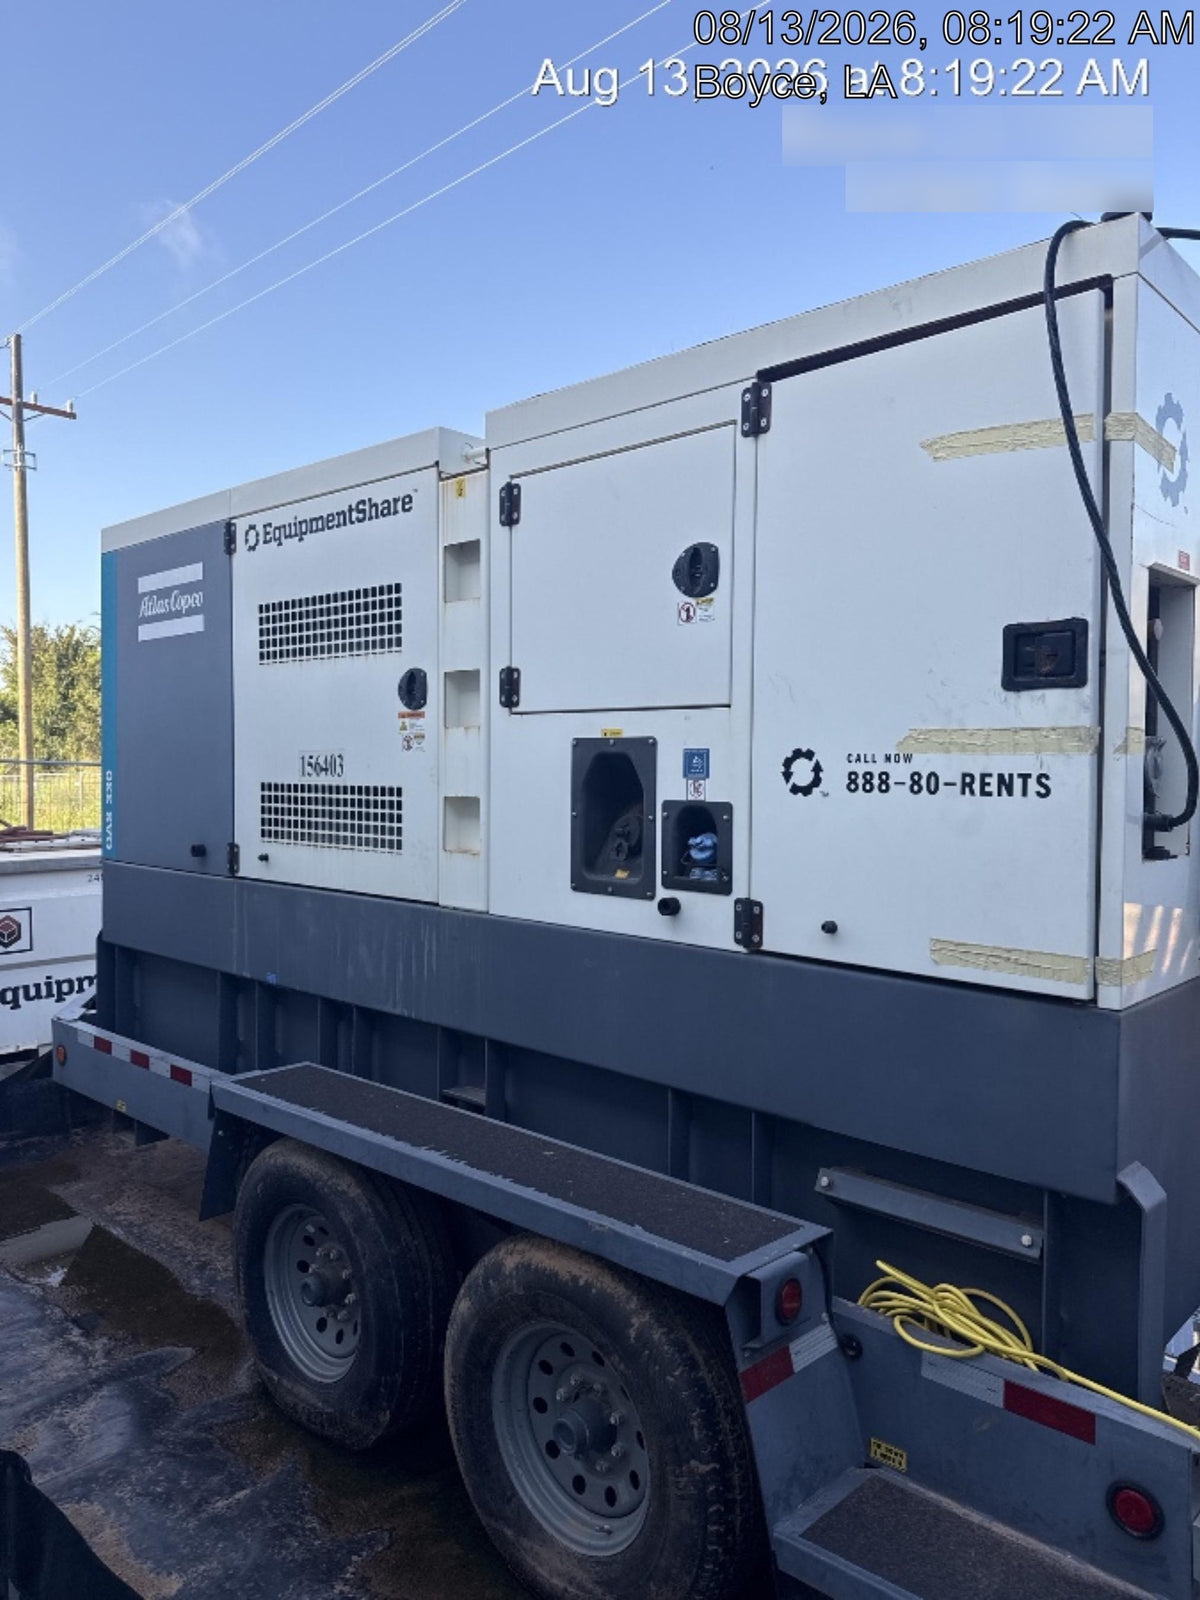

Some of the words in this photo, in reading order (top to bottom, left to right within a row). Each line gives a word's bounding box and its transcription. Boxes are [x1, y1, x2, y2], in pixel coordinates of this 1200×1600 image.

[262, 493, 413, 546] EquipmentShare
[139, 595, 169, 618] Atlas
[170, 590, 204, 614] Copco
[300, 753, 344, 777] 156403
[846, 753, 877, 764] CALL
[884, 753, 913, 764] NOW
[846, 771, 1051, 799] 888-80-RENTS
